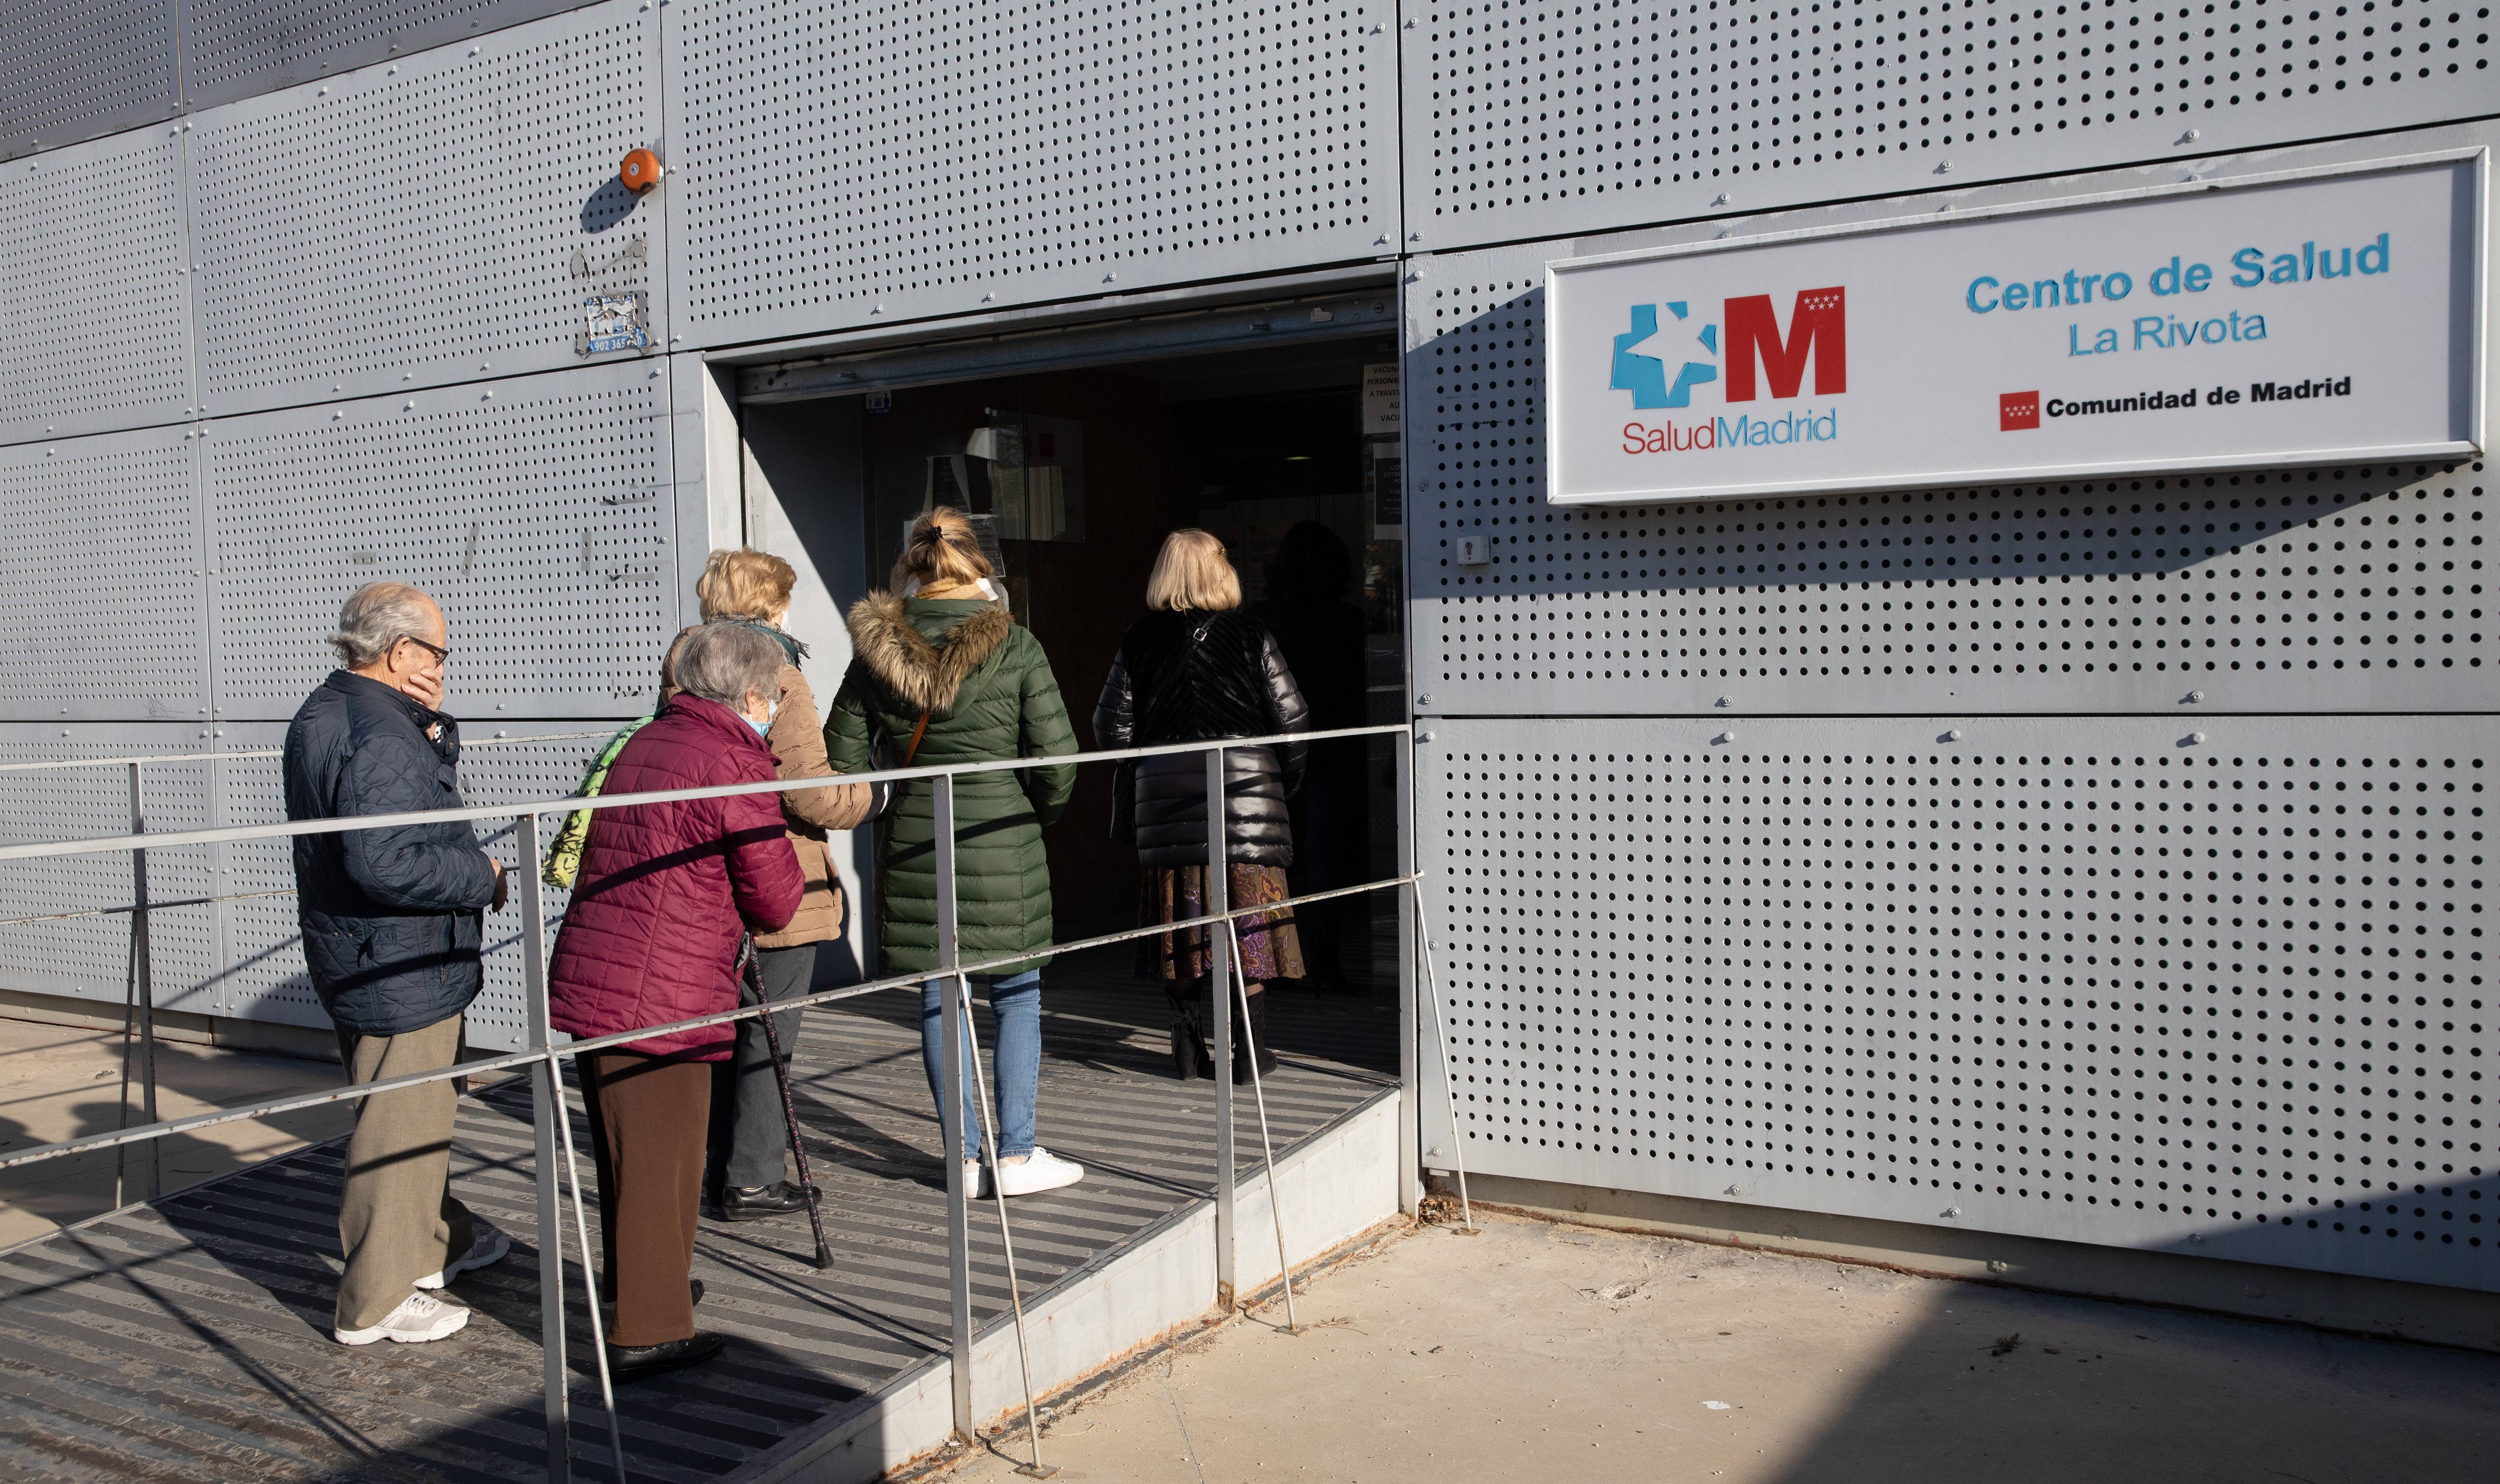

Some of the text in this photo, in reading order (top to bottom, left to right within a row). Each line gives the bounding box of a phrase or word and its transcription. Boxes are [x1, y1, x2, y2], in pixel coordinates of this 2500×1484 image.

[1967, 233, 2389, 313] Centro de Salud
[595, 340, 609, 352] 902
[611, 338, 626, 349] 365
[2069, 309, 2267, 356] La Rivota
[2046, 376, 2352, 417] Comunidad de Madrid
